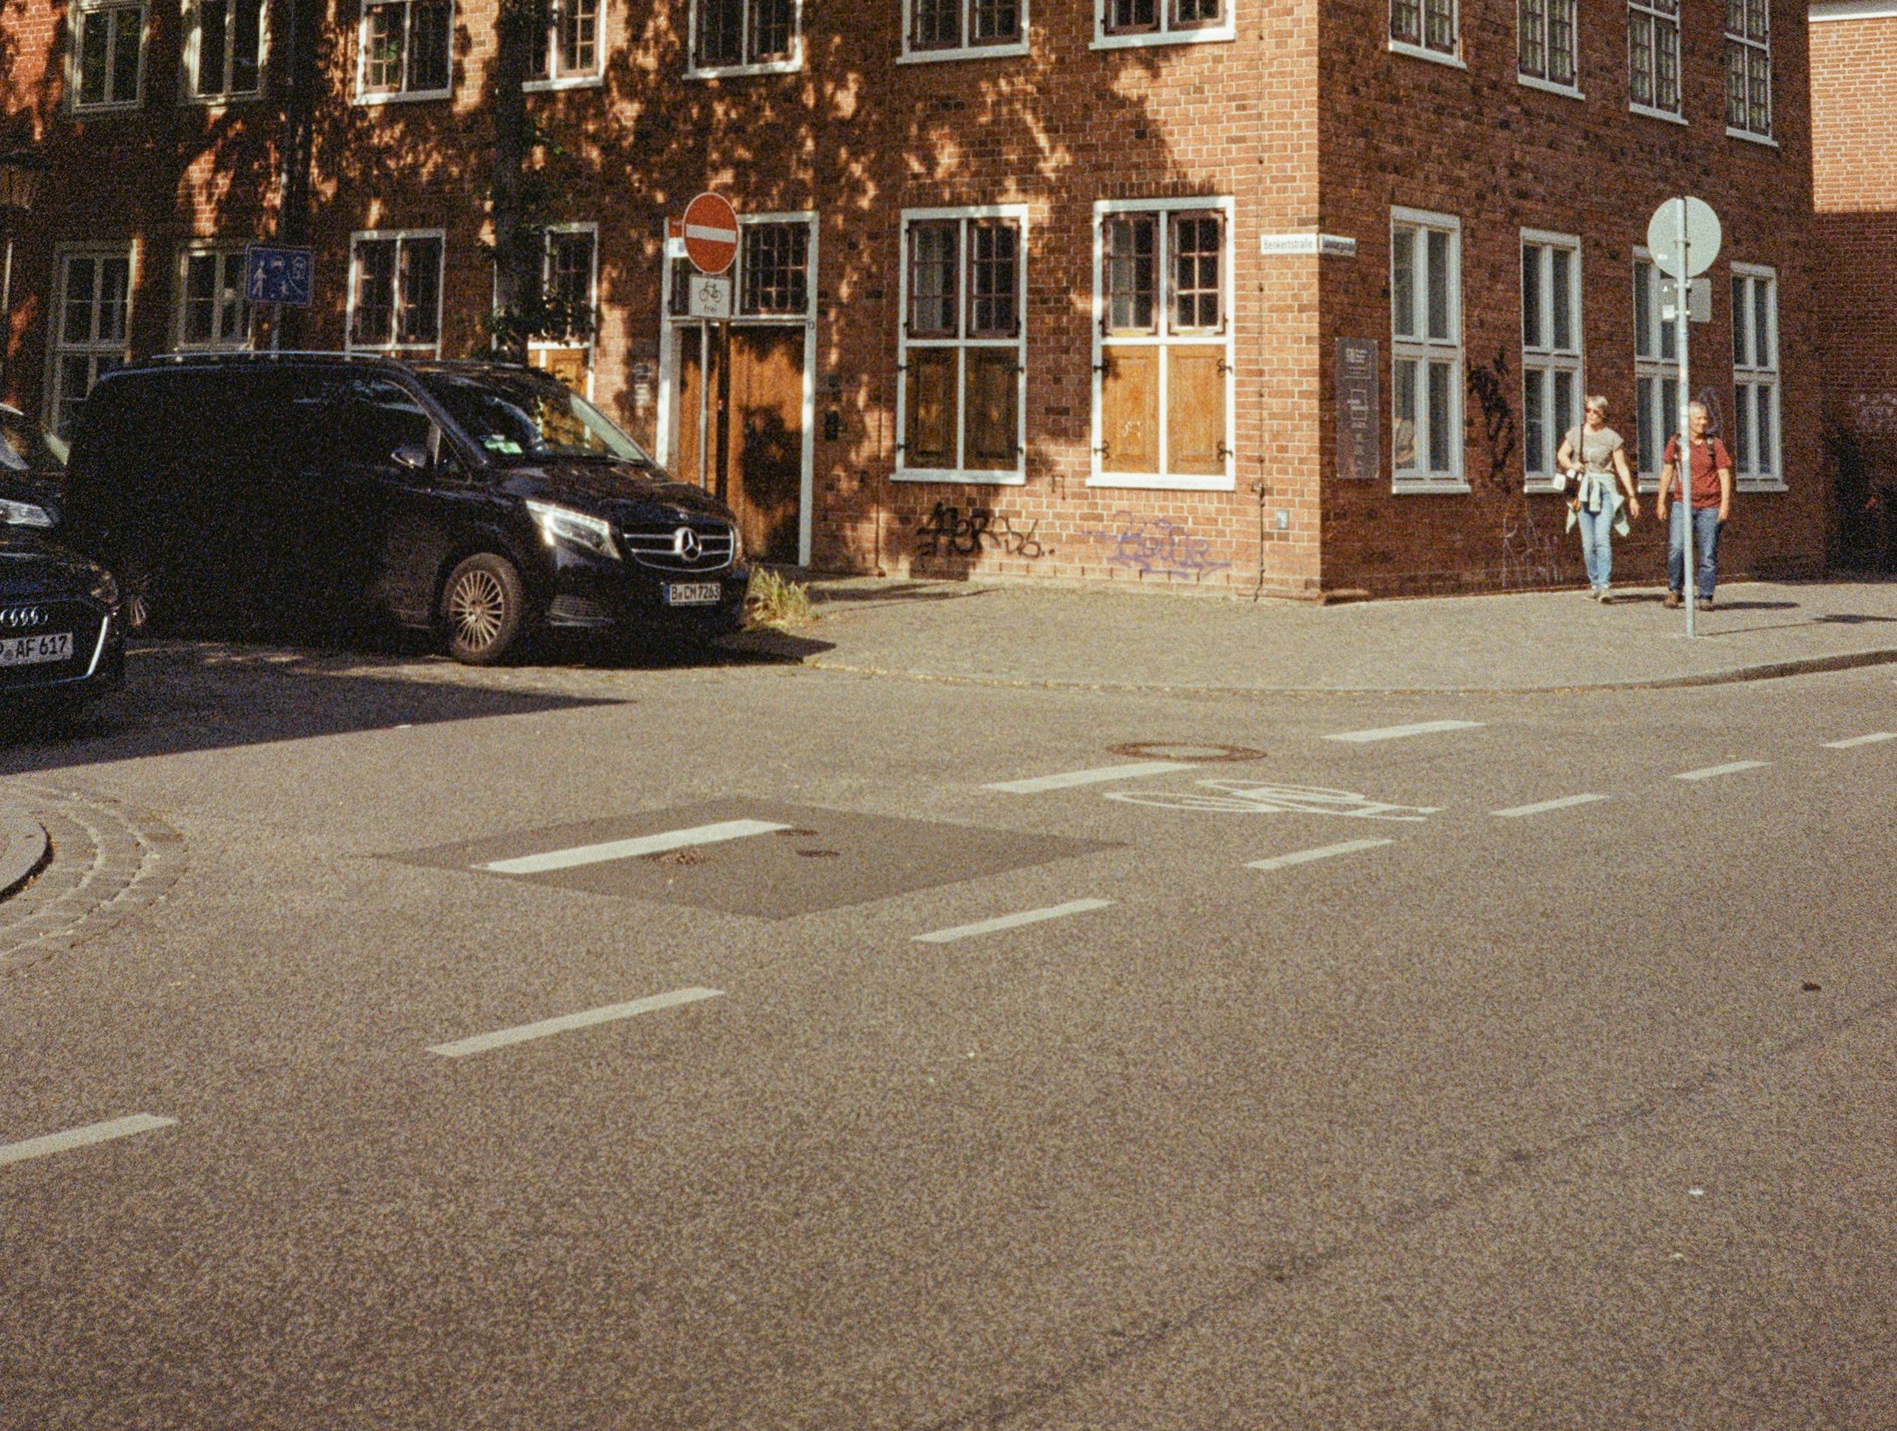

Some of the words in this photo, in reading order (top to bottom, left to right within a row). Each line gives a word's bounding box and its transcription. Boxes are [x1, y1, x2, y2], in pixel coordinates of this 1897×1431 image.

[704, 304, 717, 314] frei
[671, 586, 678, 600] B
[15, 638, 35, 658] AF
[39, 634, 67, 655] 617
